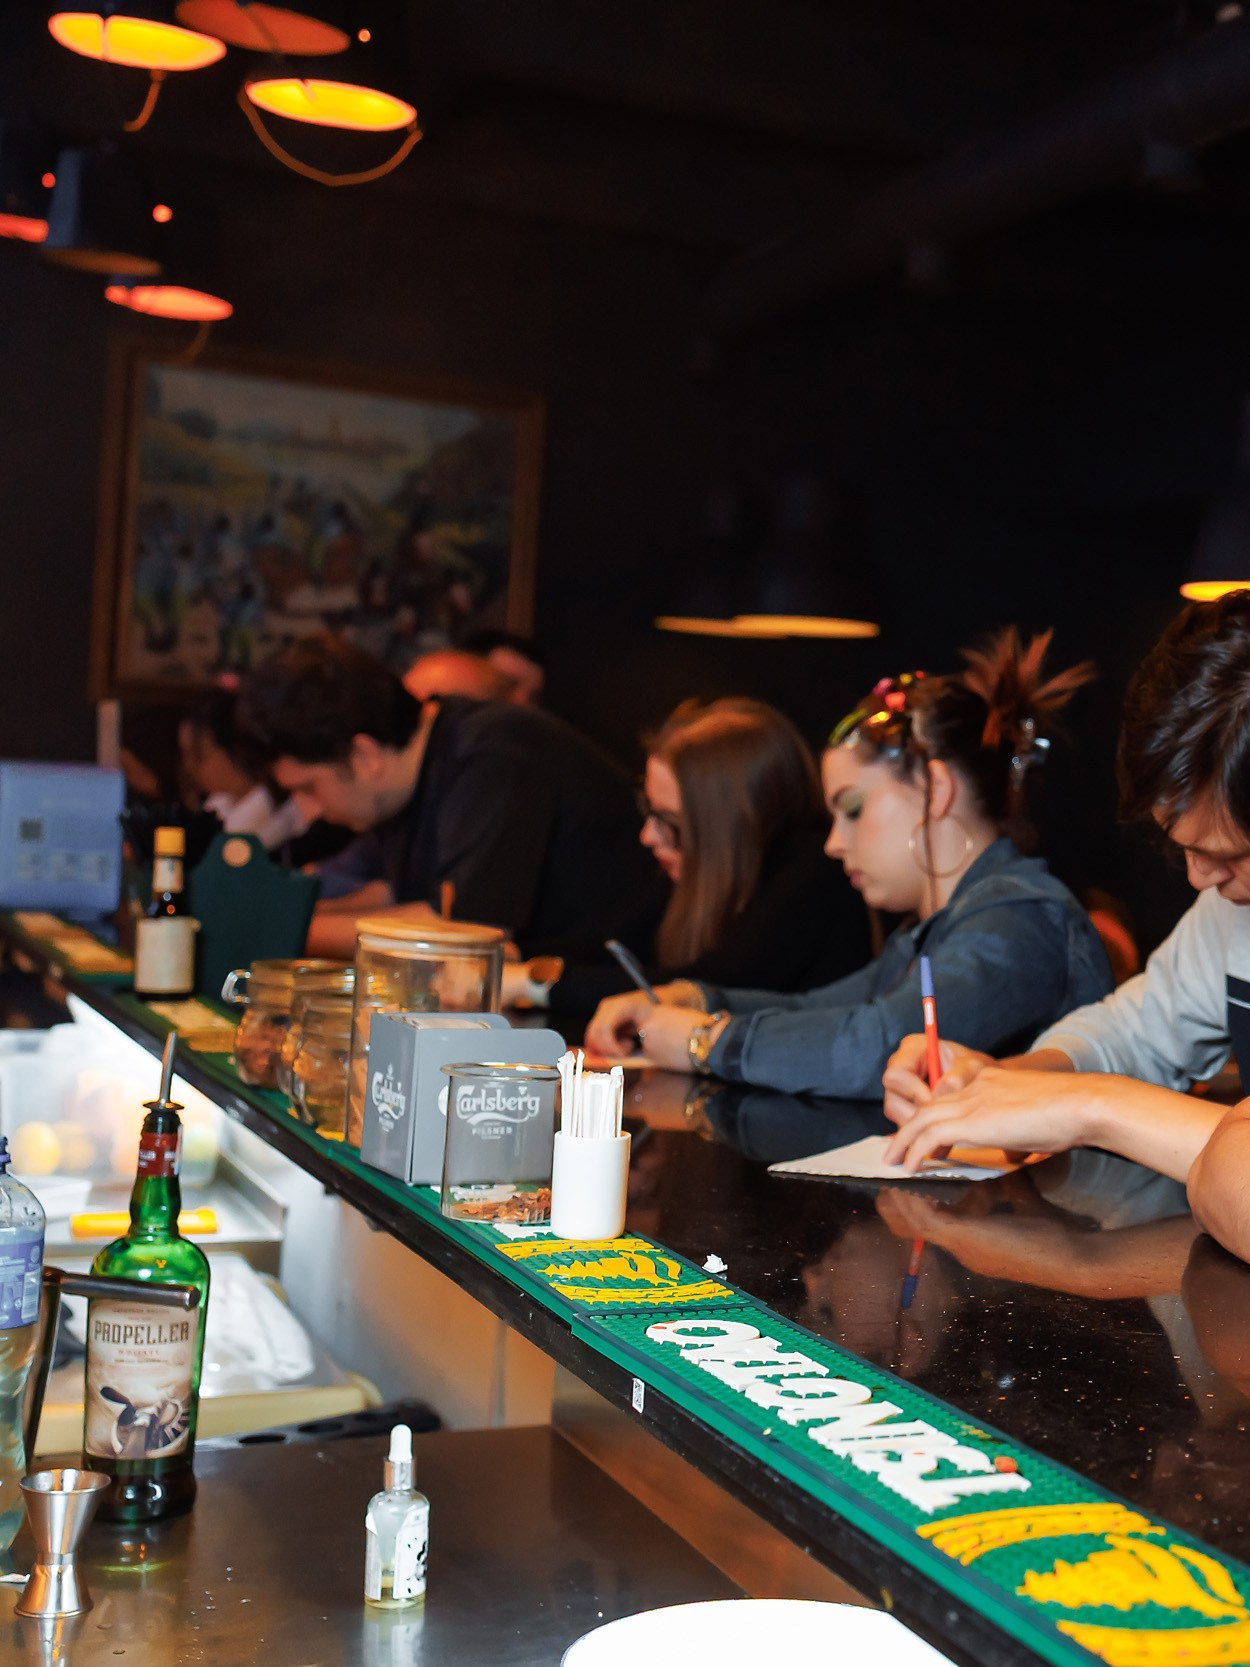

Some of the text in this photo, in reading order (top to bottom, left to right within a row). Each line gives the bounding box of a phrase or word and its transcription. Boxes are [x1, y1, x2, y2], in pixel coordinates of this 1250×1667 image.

[456, 1085, 541, 1122] Carlsberg
[94, 1320, 190, 1345] PROPELLER
[645, 1319, 1031, 1514] TSINGTAO
